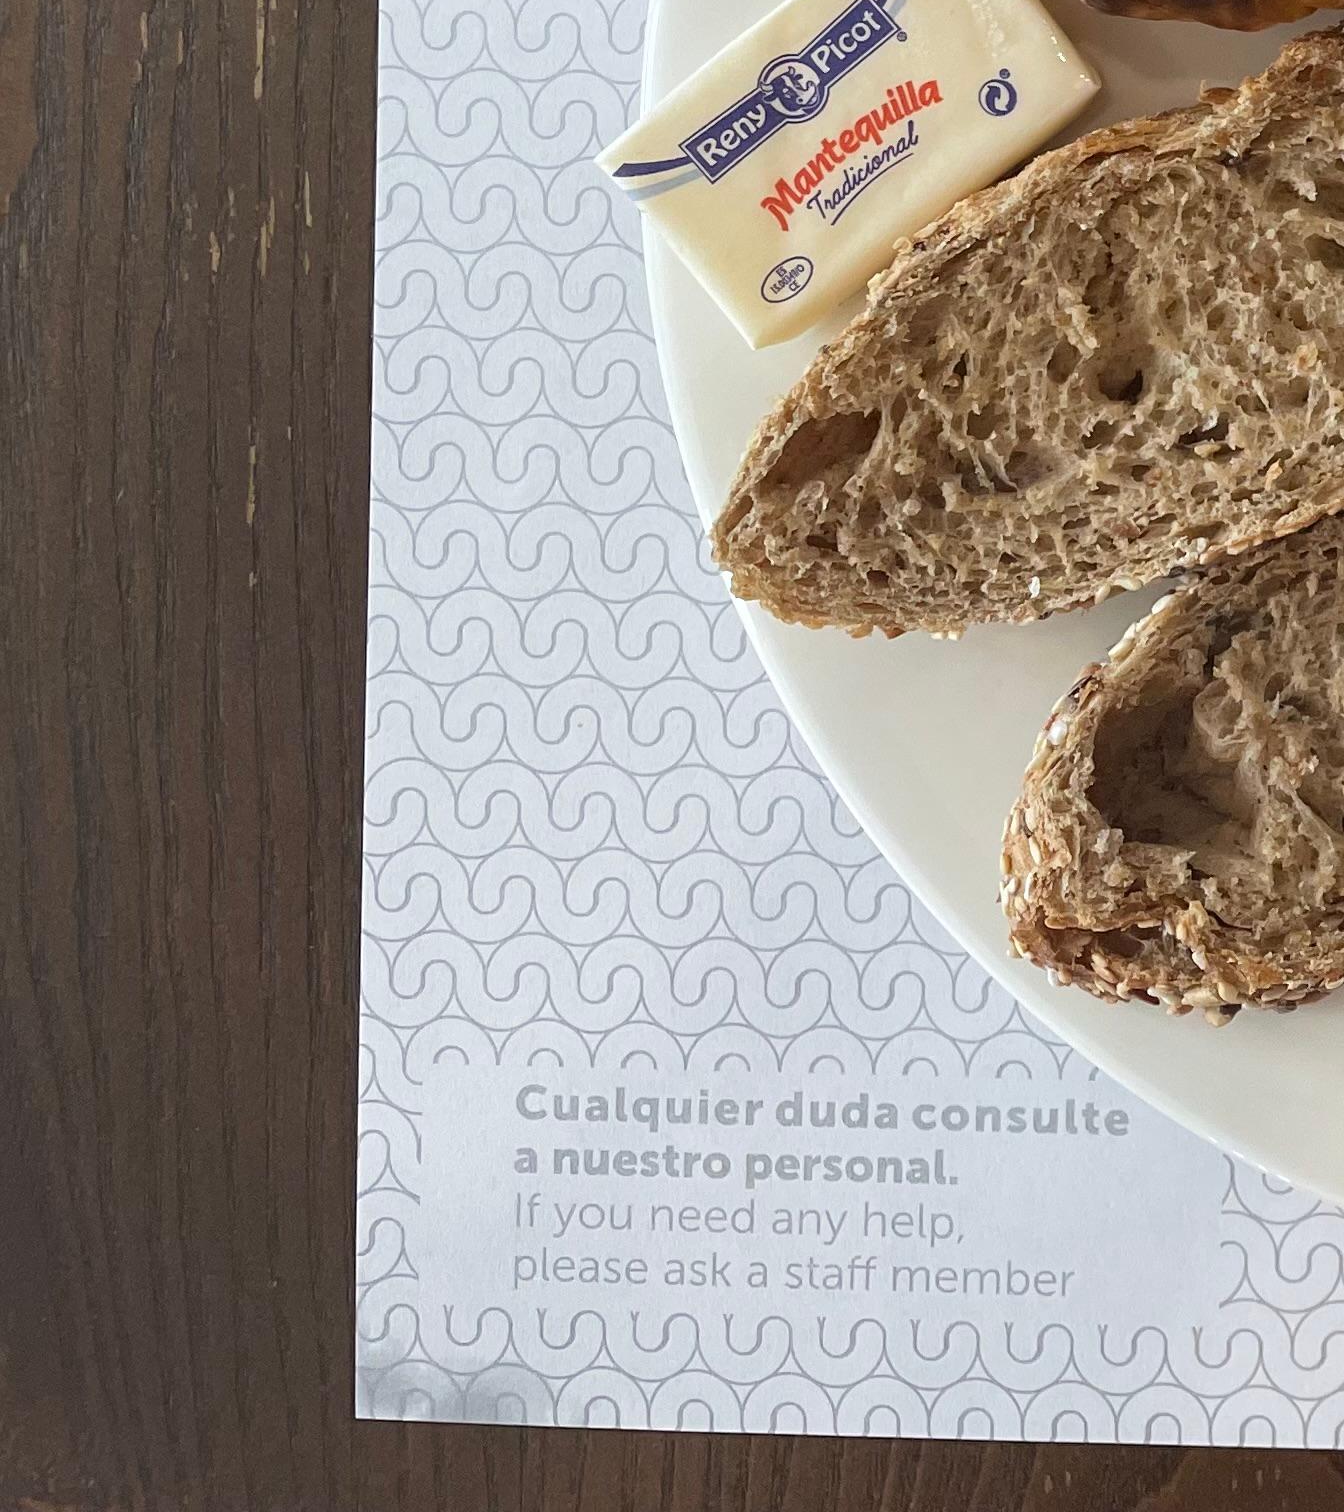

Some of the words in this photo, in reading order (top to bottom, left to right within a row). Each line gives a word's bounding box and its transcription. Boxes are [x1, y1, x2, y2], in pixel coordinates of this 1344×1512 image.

[696, 103, 766, 166] Reny
[810, 10, 880, 74] Picot
[760, 80, 943, 231] Mantequilla
[806, 120, 919, 219] Tradicional
[516, 1085, 763, 1132] Cualquier
[776, 1091, 897, 1129] duda
[912, 1099, 1129, 1136] consulte
[514, 1148, 537, 1173] a
[554, 1145, 730, 1178] nuestro
[746, 1149, 957, 1189] personal.
[516, 1193, 540, 1227] If
[553, 1204, 631, 1238] you
[652, 1199, 754, 1233] need
[772, 1209, 847, 1245] any
[864, 1202, 963, 1247] help,
[514, 1249, 647, 1289] please
[664, 1252, 730, 1286] ask
[748, 1262, 767, 1287] a
[786, 1256, 876, 1290] staff
[893, 1261, 1074, 1296] member
